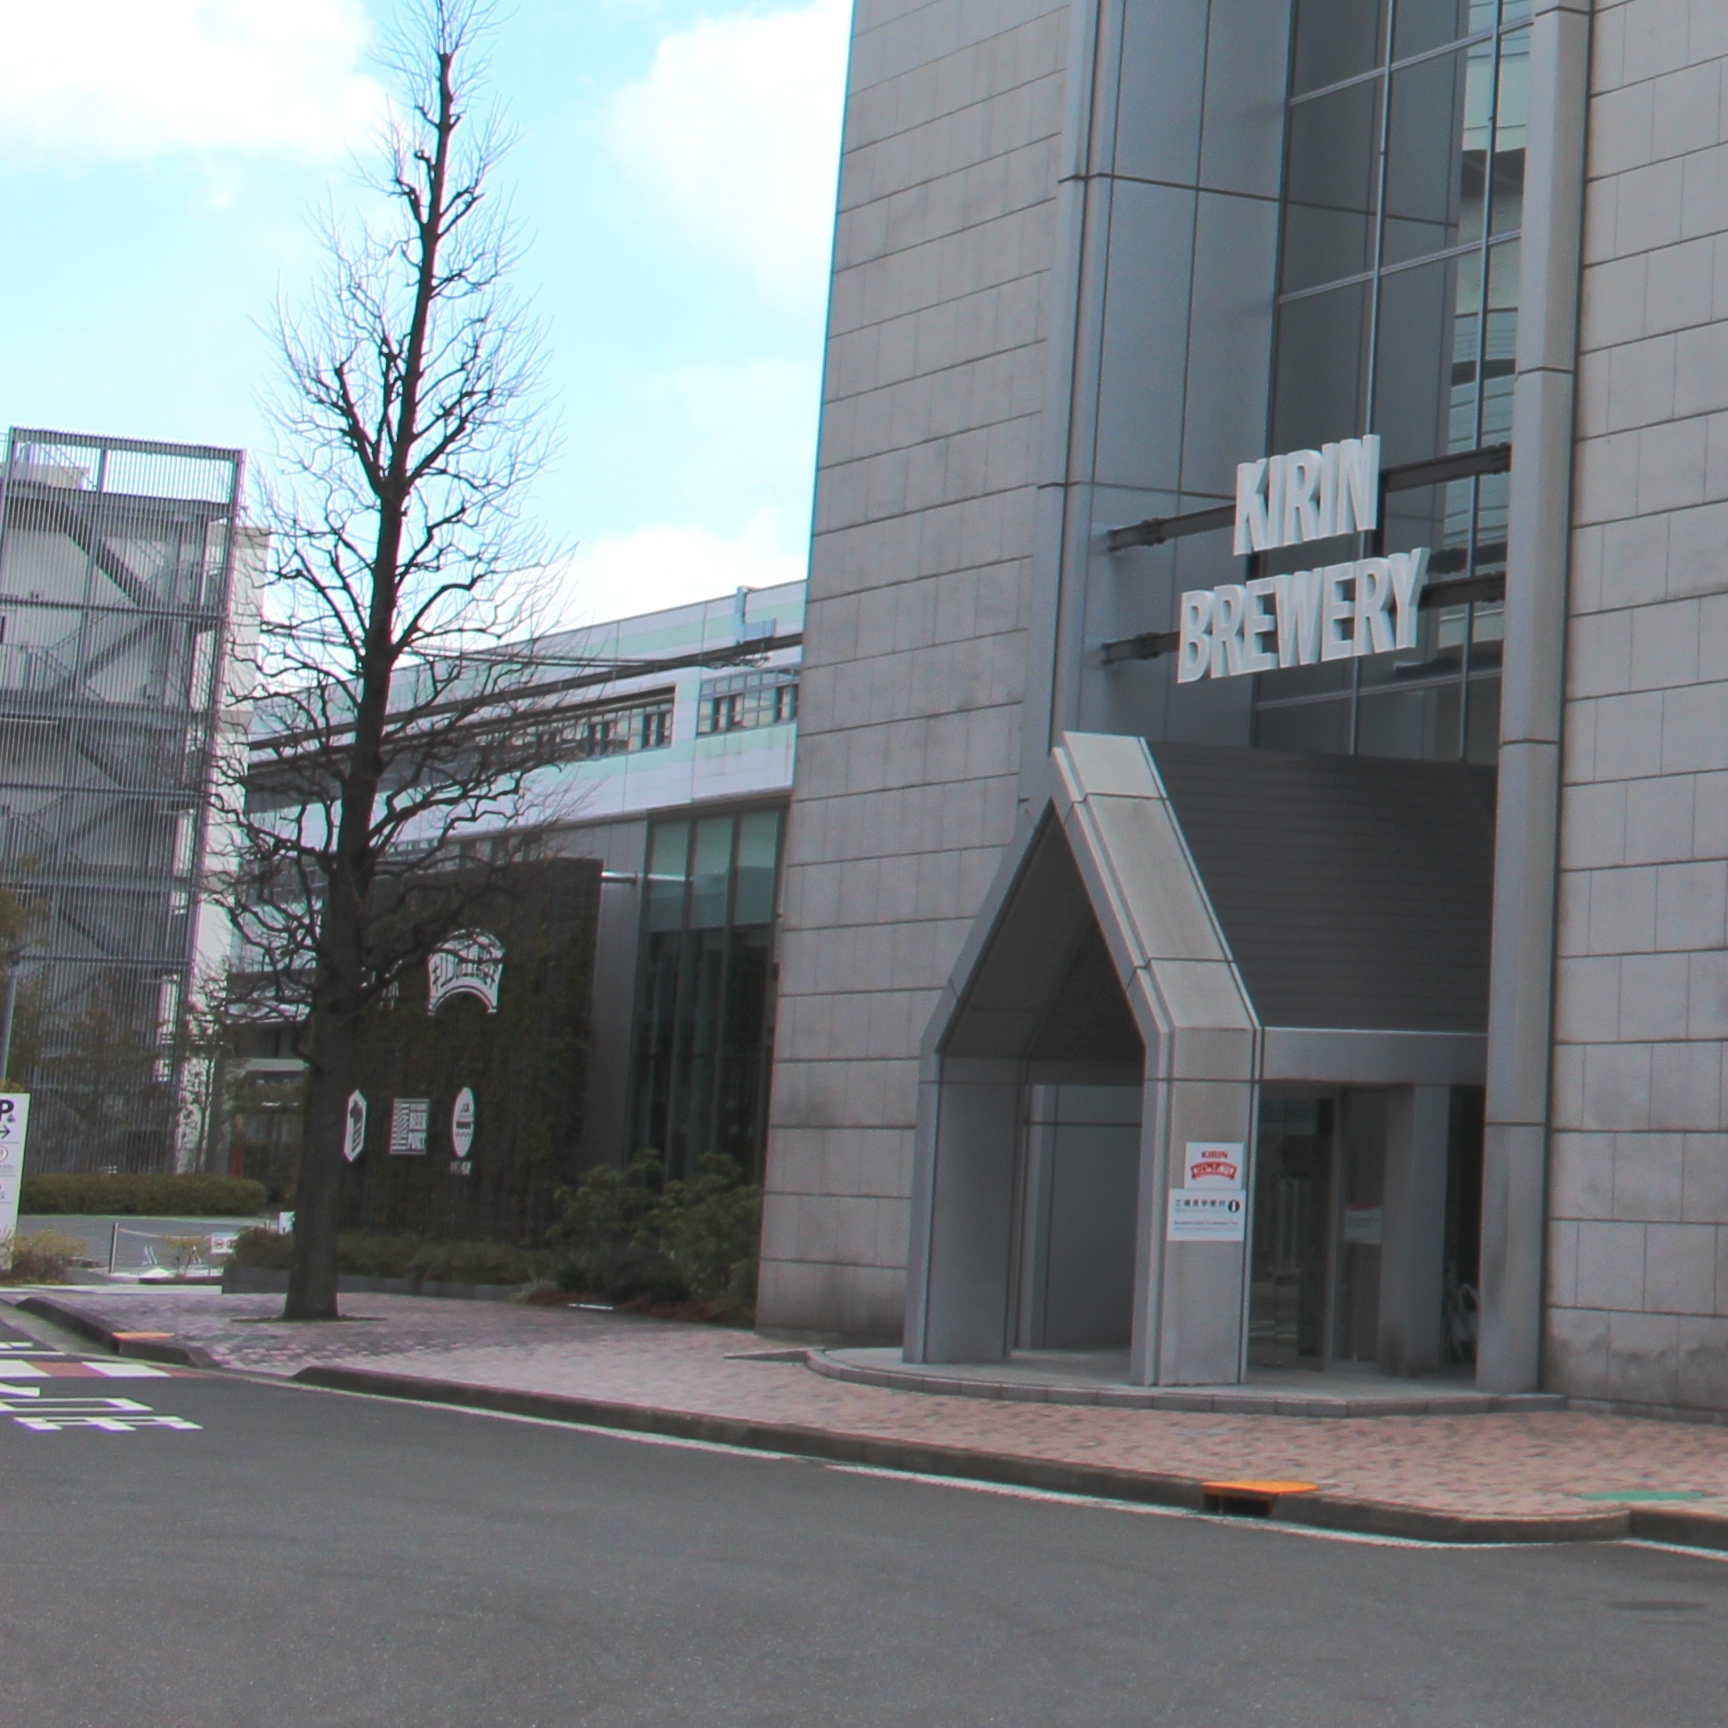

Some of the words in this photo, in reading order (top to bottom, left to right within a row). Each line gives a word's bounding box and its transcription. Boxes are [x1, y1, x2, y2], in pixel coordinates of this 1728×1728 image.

[1233, 434, 1380, 555] KIRIN
[1178, 547, 1430, 683] BREWERY
[1201, 1150, 1228, 1159] KIRIN
